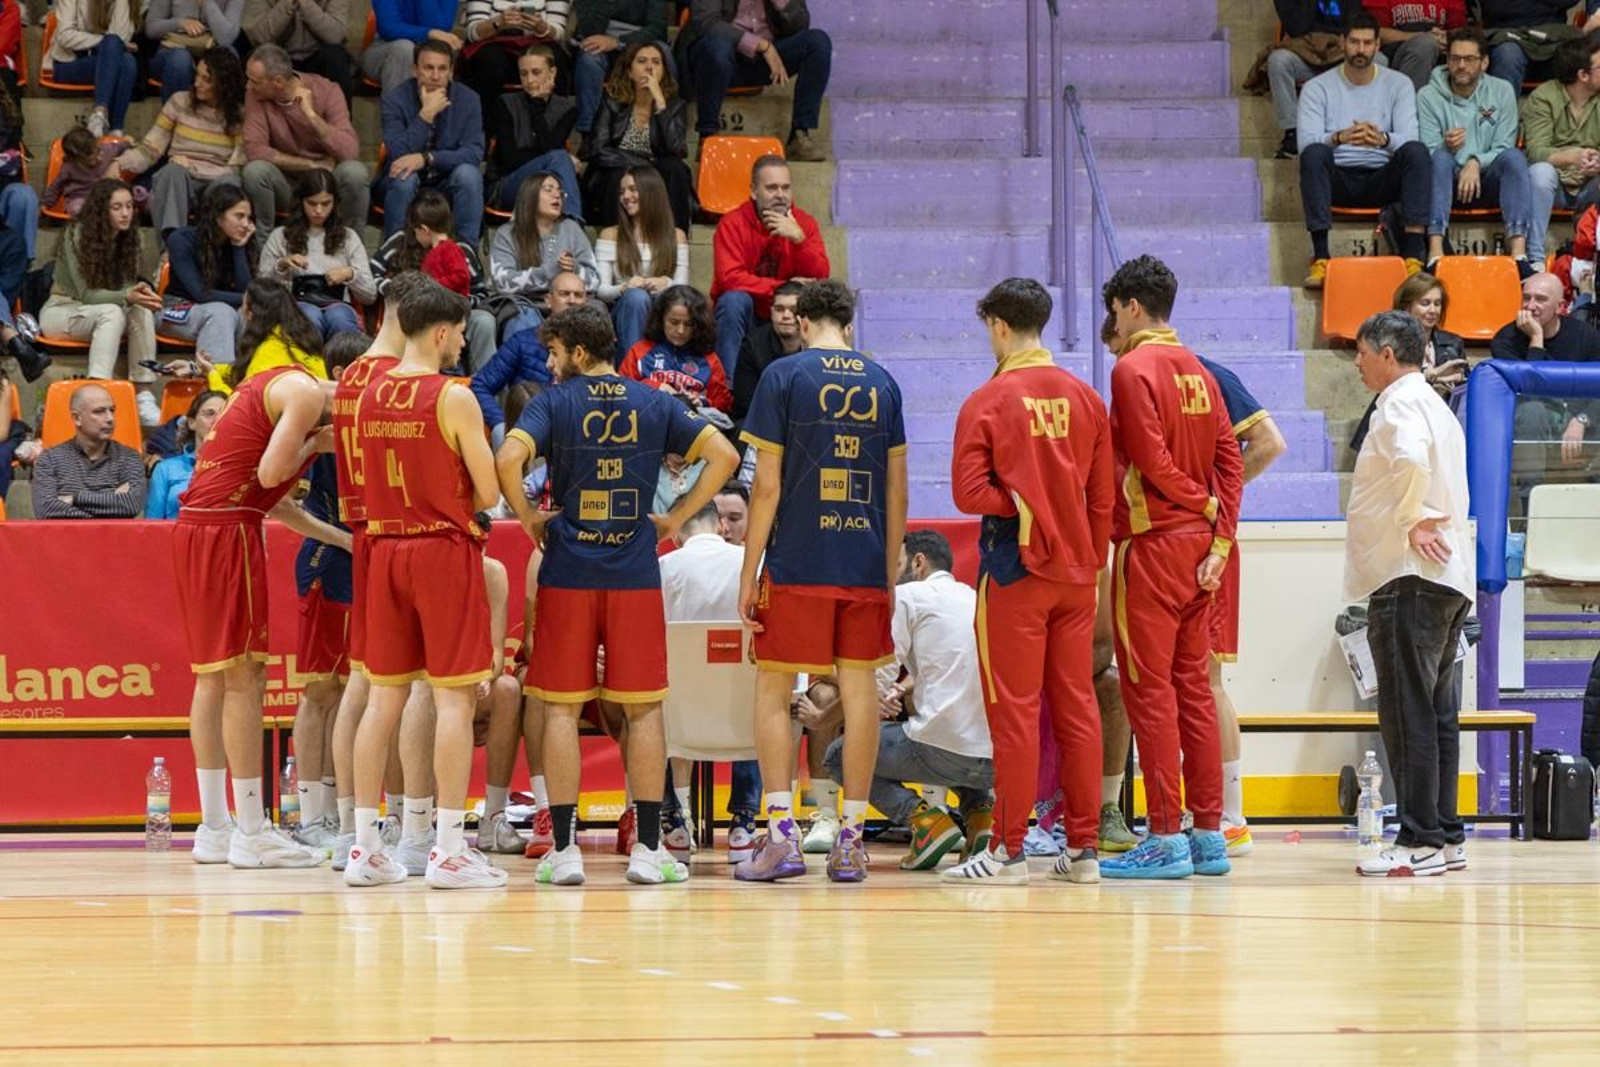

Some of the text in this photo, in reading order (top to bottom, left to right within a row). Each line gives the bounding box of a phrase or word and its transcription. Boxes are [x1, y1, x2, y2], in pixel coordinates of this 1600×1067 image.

[821, 355, 865, 371] vive
[587, 381, 627, 396] vive
[386, 448, 412, 507] 4
